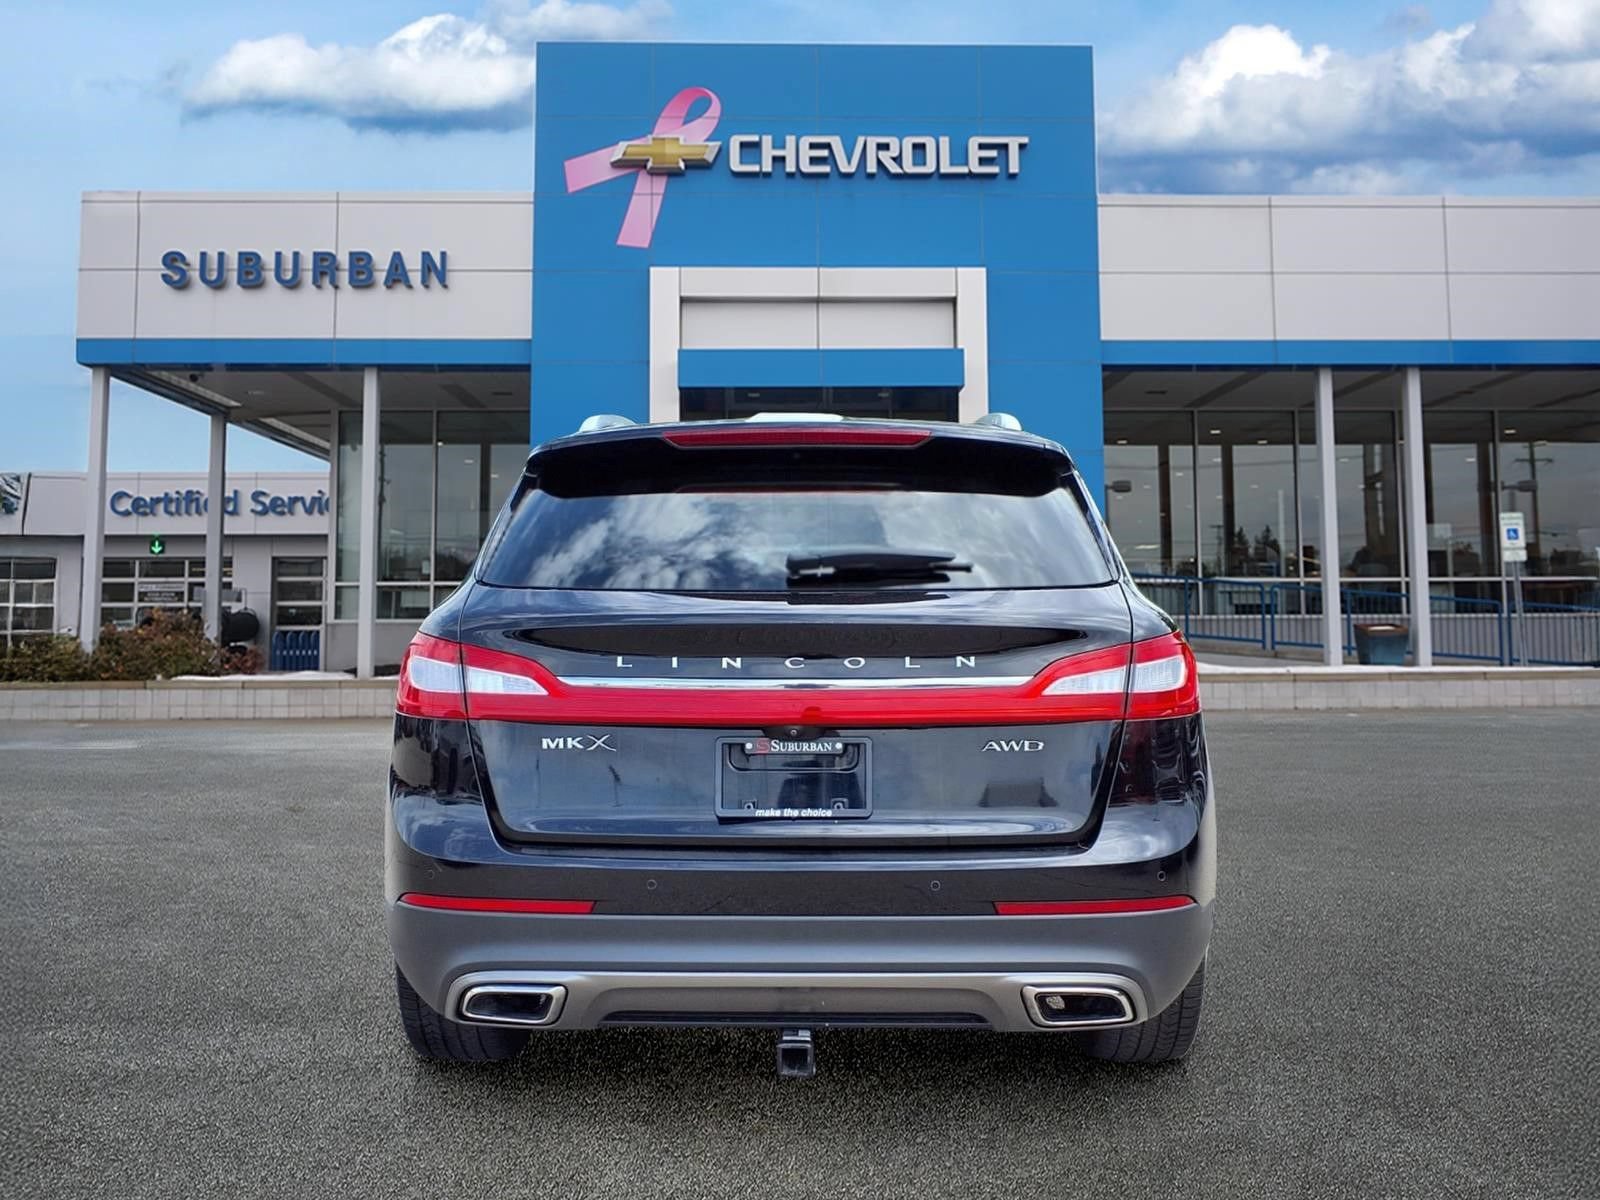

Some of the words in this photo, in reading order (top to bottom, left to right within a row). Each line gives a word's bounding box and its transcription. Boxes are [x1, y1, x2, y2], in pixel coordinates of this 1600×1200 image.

[729, 134, 1029, 175] CHEVROLET
[161, 250, 449, 289] SUBURBAN
[110, 488, 240, 517] Certifid
[250, 489, 329, 517] Servi
[616, 656, 976, 669] LINCOLN
[541, 734, 617, 752] MKX
[770, 739, 832, 752] SUBURBAN
[982, 739, 1045, 752] AWD
[755, 807, 781, 817] make
[783, 807, 799, 817] the
[801, 807, 833, 817] choice
